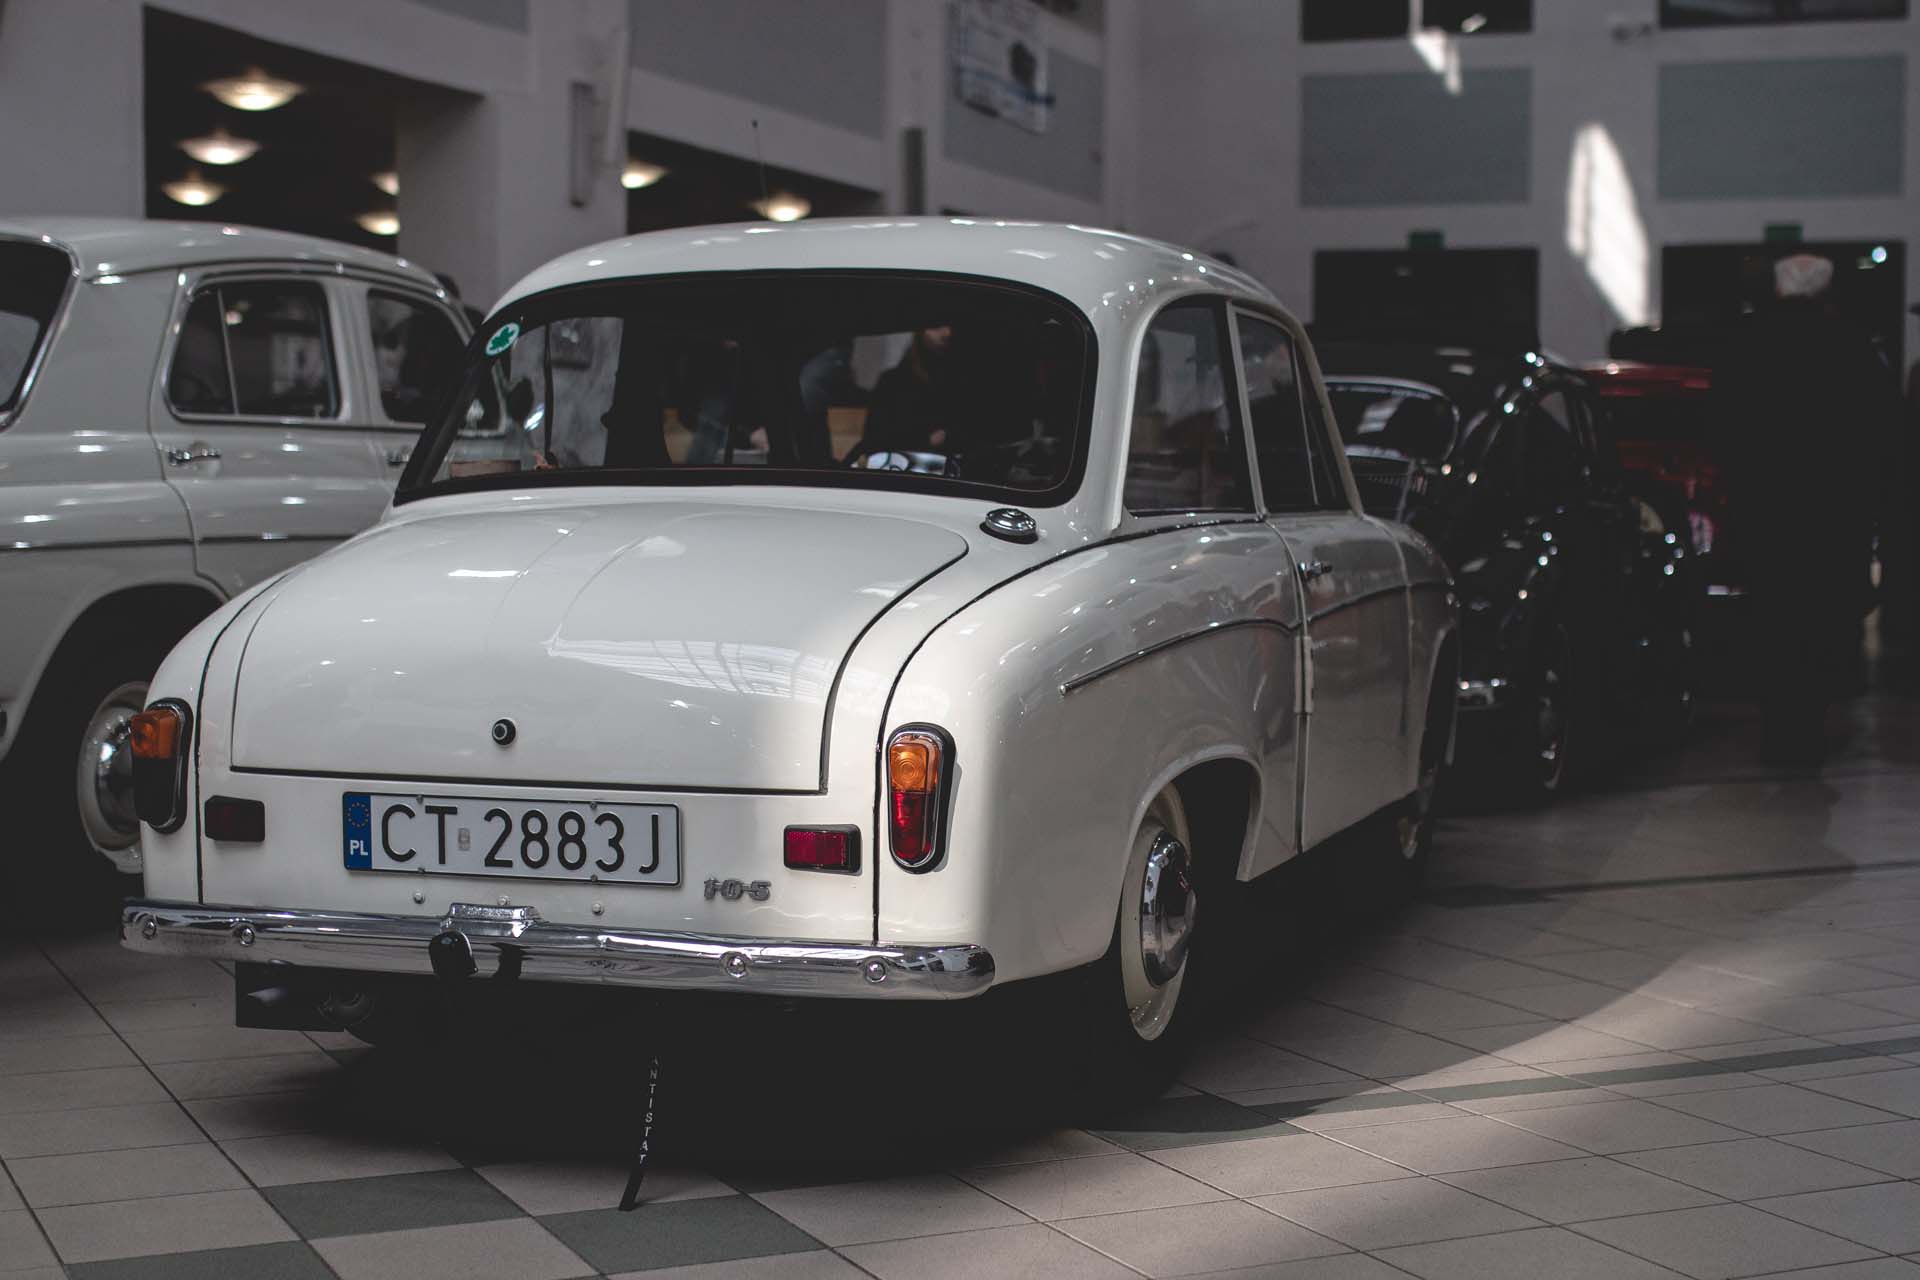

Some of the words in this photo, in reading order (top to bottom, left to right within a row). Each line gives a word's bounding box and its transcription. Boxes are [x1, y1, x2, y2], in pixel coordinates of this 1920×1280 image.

[349, 839, 369, 856] PL
[381, 803, 458, 865] CT
[483, 808, 660, 875] 2883J
